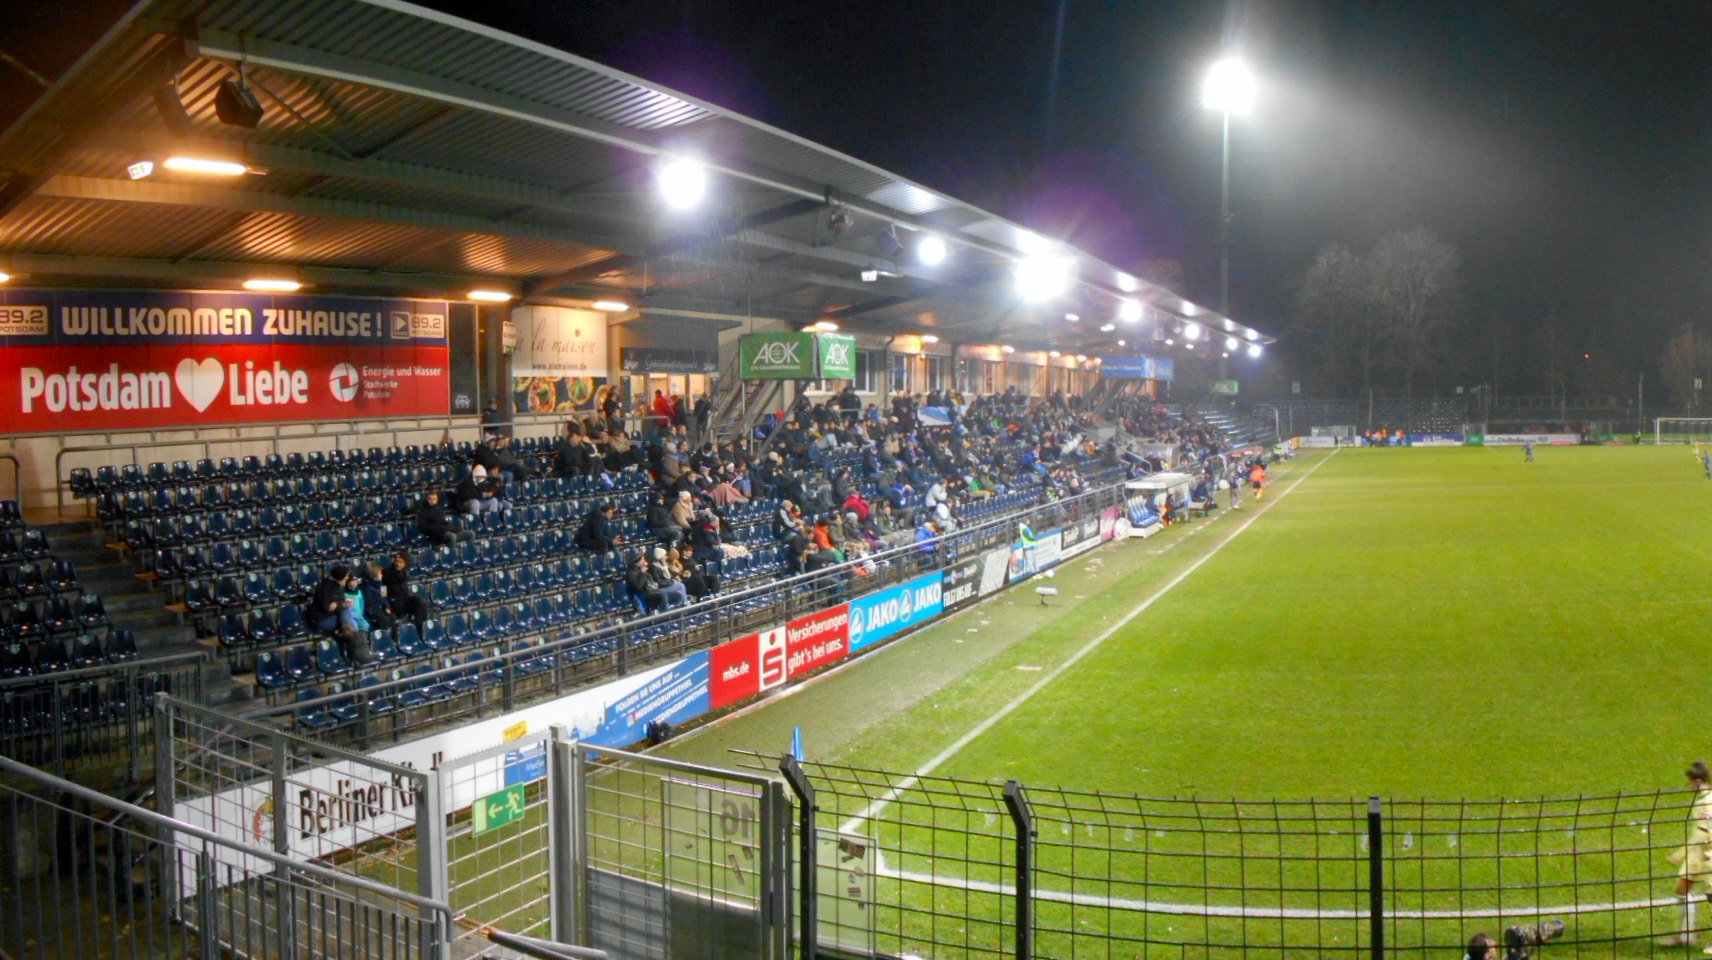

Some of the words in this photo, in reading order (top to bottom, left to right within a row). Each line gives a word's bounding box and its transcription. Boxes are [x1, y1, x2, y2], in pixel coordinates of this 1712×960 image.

[61, 306, 252, 336] WILLKOMMEN
[411, 315, 441, 329] 89.2
[551, 339, 598, 354] maison
[753, 341, 800, 365] AOK
[824, 343, 849, 365] AOK
[362, 365, 395, 378] Energie
[396, 365, 412, 377] und
[413, 365, 443, 377] Wasser
[20, 362, 172, 414] Potsdam
[228, 360, 309, 406] Liebe
[866, 598, 899, 633] JAKO
[913, 581, 942, 613] JAKO
[787, 611, 848, 645] Versicherungen
[787, 649, 813, 674] gibt's
[812, 642, 825, 658] bei
[825, 638, 844, 655] uns.
[722, 661, 750, 682] mbs.de
[298, 778, 388, 841] Berliner
